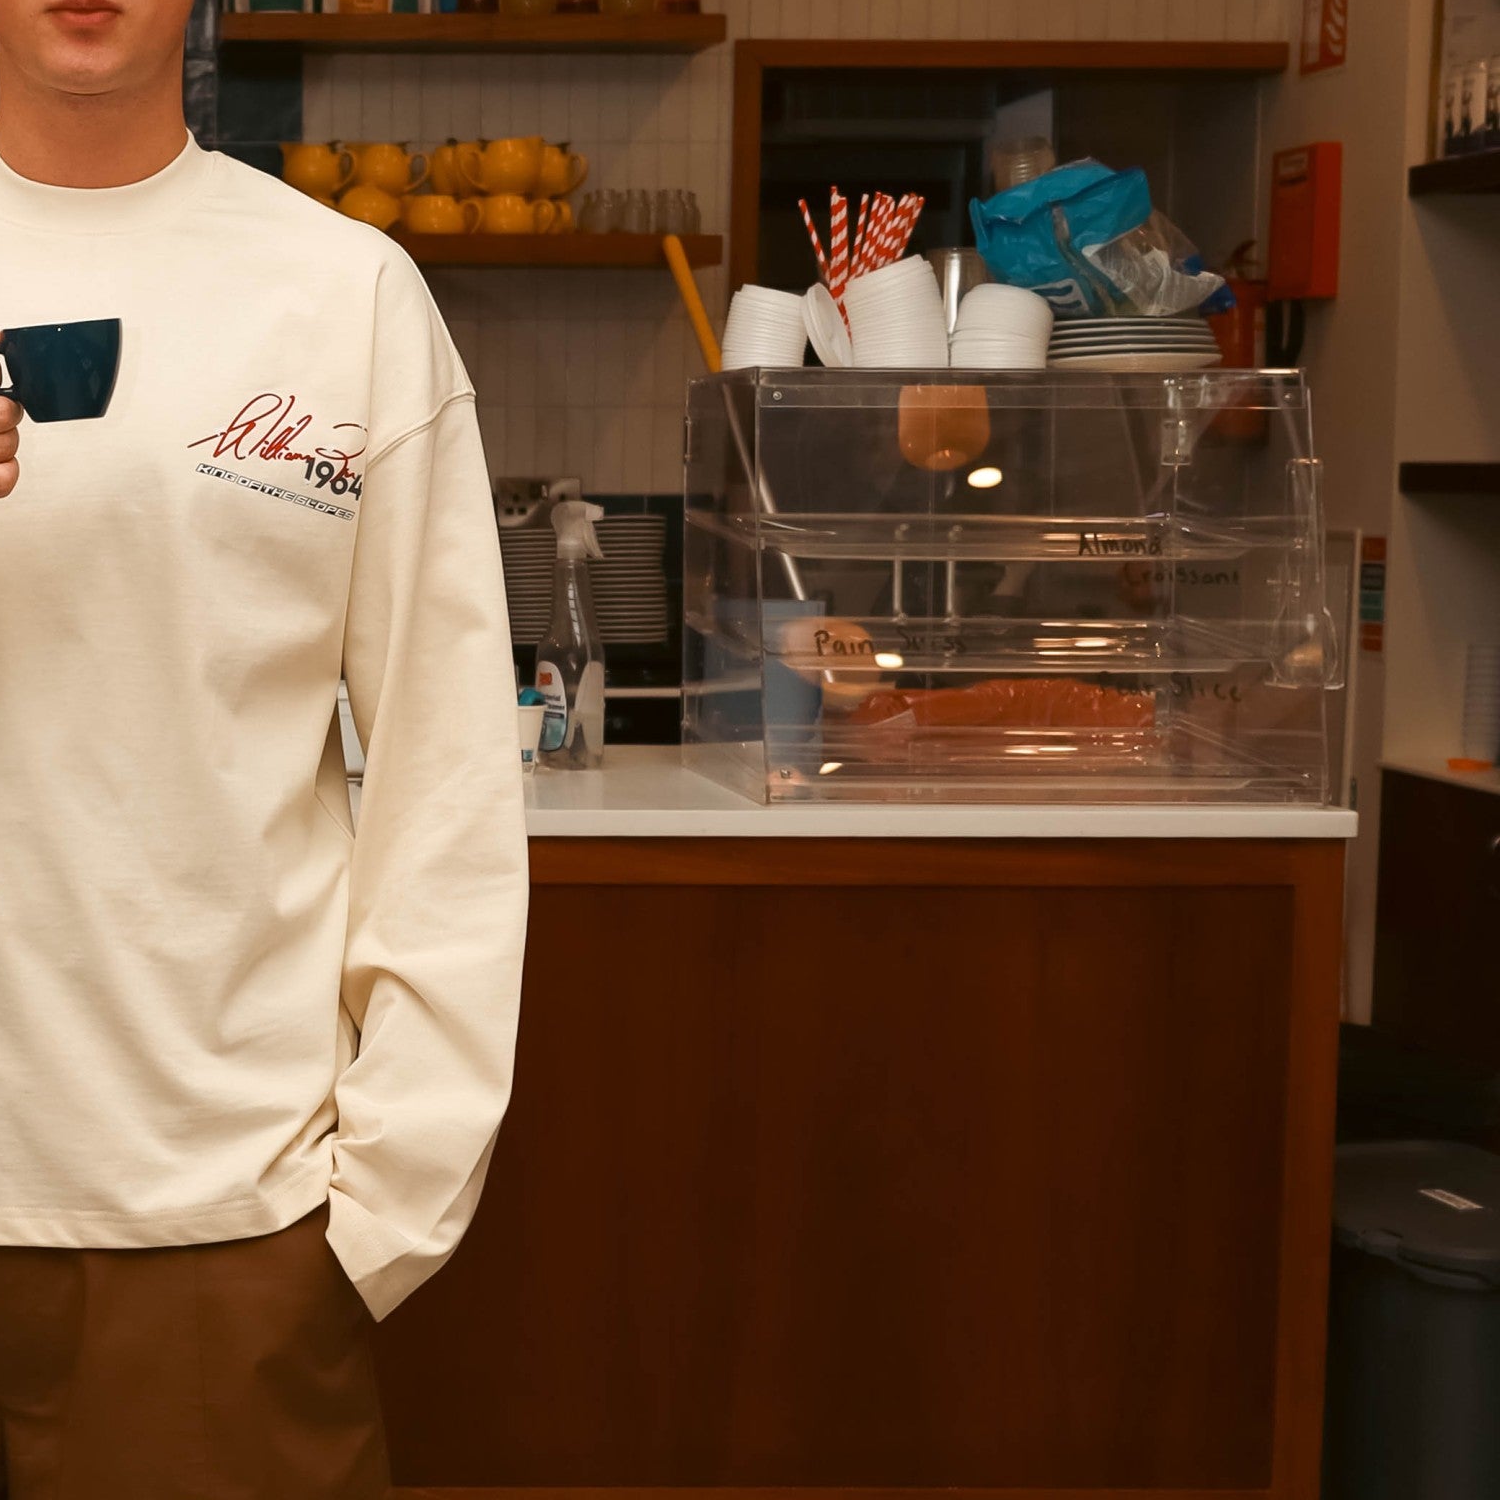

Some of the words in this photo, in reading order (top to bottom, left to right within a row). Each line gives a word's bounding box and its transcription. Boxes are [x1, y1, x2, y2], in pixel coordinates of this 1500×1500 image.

[196, 463, 238, 482] KING
[237, 475, 262, 491] OF
[260, 483, 296, 501] THE
[294, 494, 356, 521] SLOPES
[303, 457, 363, 501] 1964
[1078, 532, 1163, 556] Almond
[813, 629, 875, 657] Pain
